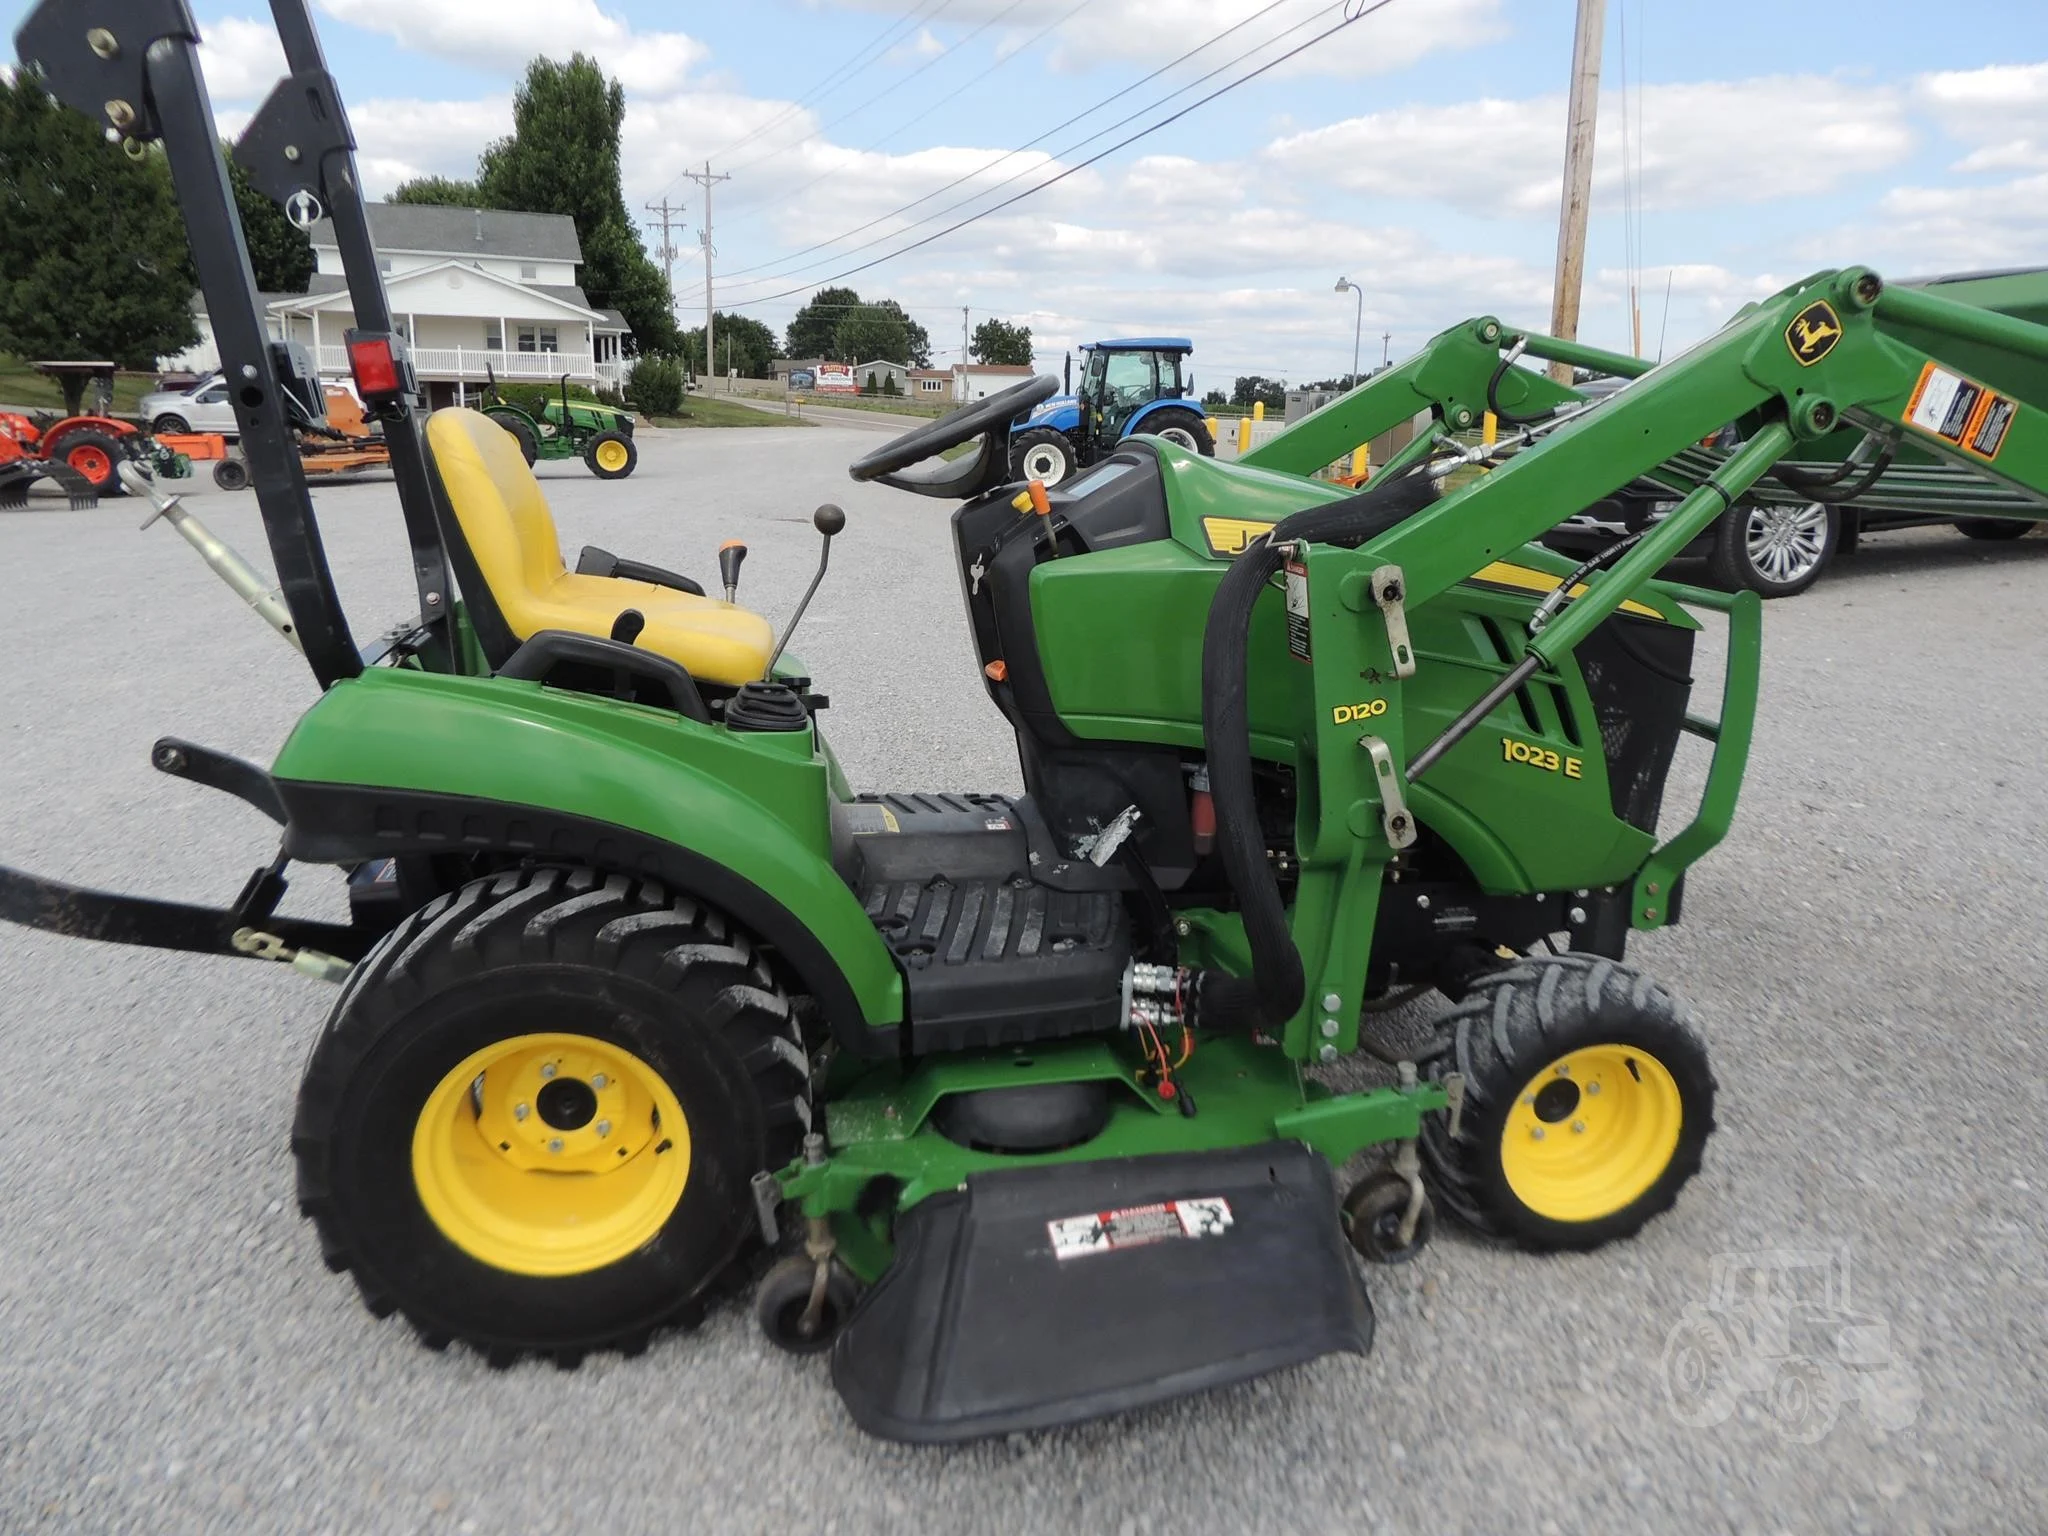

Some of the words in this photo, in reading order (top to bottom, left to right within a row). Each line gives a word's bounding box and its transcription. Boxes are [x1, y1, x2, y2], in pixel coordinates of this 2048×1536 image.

[1333, 698, 1388, 724] D120
[1502, 738, 1560, 771] 1023
[1565, 756, 1582, 778] E
